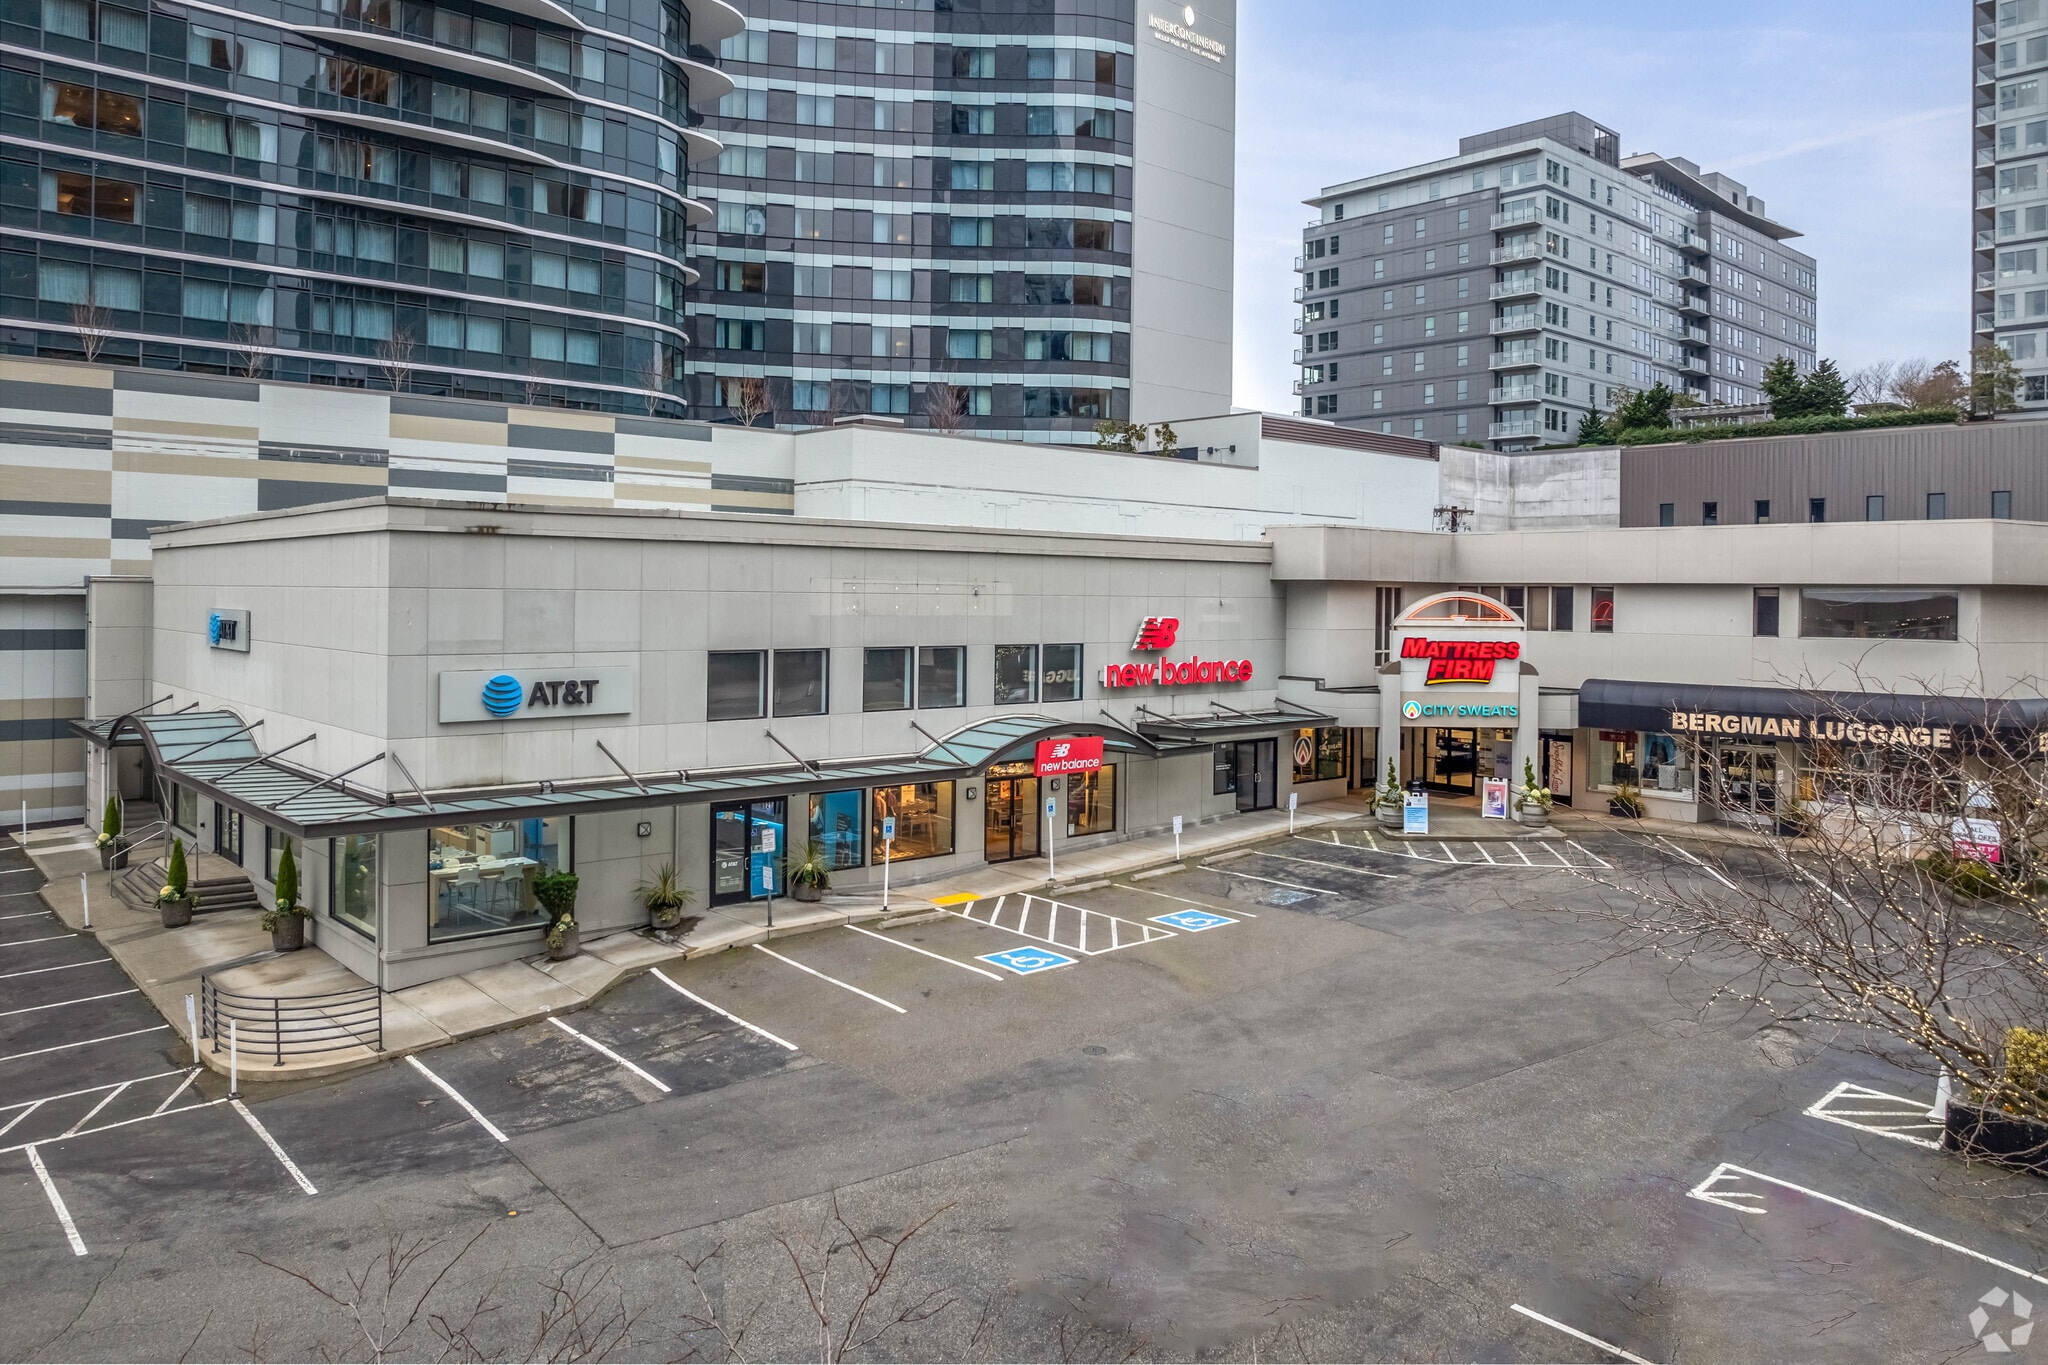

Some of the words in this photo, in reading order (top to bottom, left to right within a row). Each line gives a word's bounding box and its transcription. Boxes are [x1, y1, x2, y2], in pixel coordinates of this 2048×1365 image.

[1104, 663, 1157, 688] new
[1158, 656, 1253, 686] balance
[1427, 659, 1496, 681] FIRM
[528, 680, 599, 706] AT&T
[1423, 704, 1455, 716] CITY
[1458, 705, 1519, 718] SWEATS
[1671, 712, 1800, 738] BERGMAN
[1809, 720, 1952, 749] LUGGAGE
[1041, 762, 1061, 772] new
[1061, 758, 1100, 770] balance
